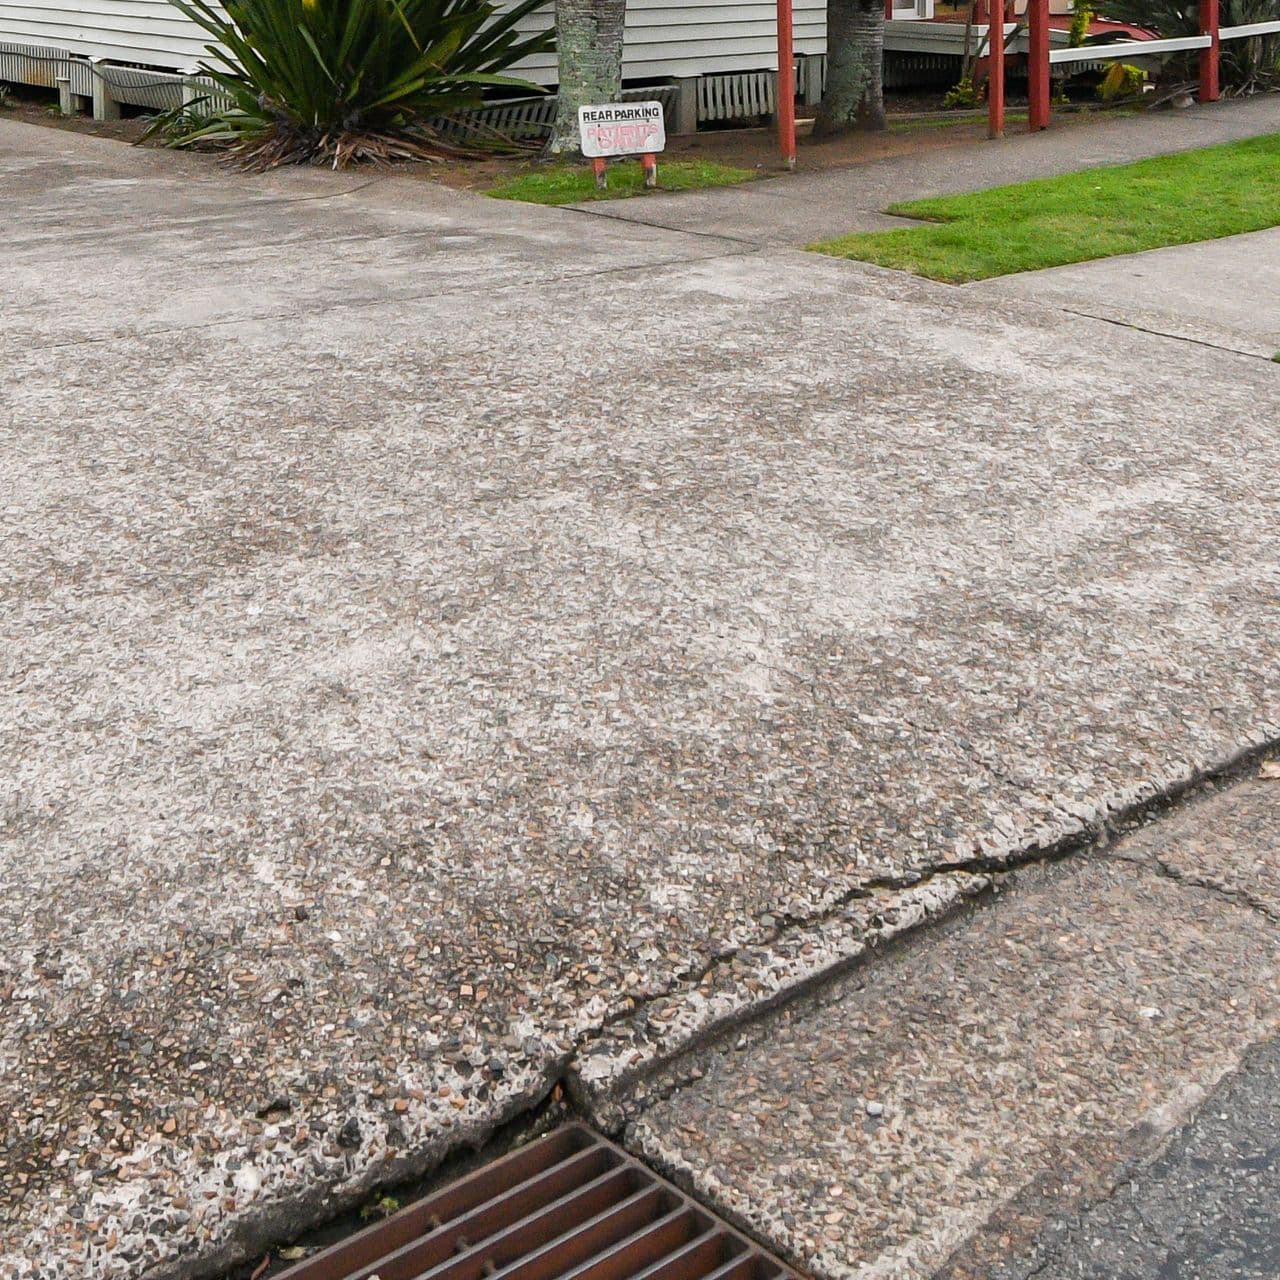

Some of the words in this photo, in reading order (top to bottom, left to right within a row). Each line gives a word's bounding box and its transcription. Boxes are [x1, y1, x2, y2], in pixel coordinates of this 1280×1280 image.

[583, 110, 612, 121] REAR
[614, 107, 659, 119] PARKING
[586, 123, 659, 139] PATIENTS
